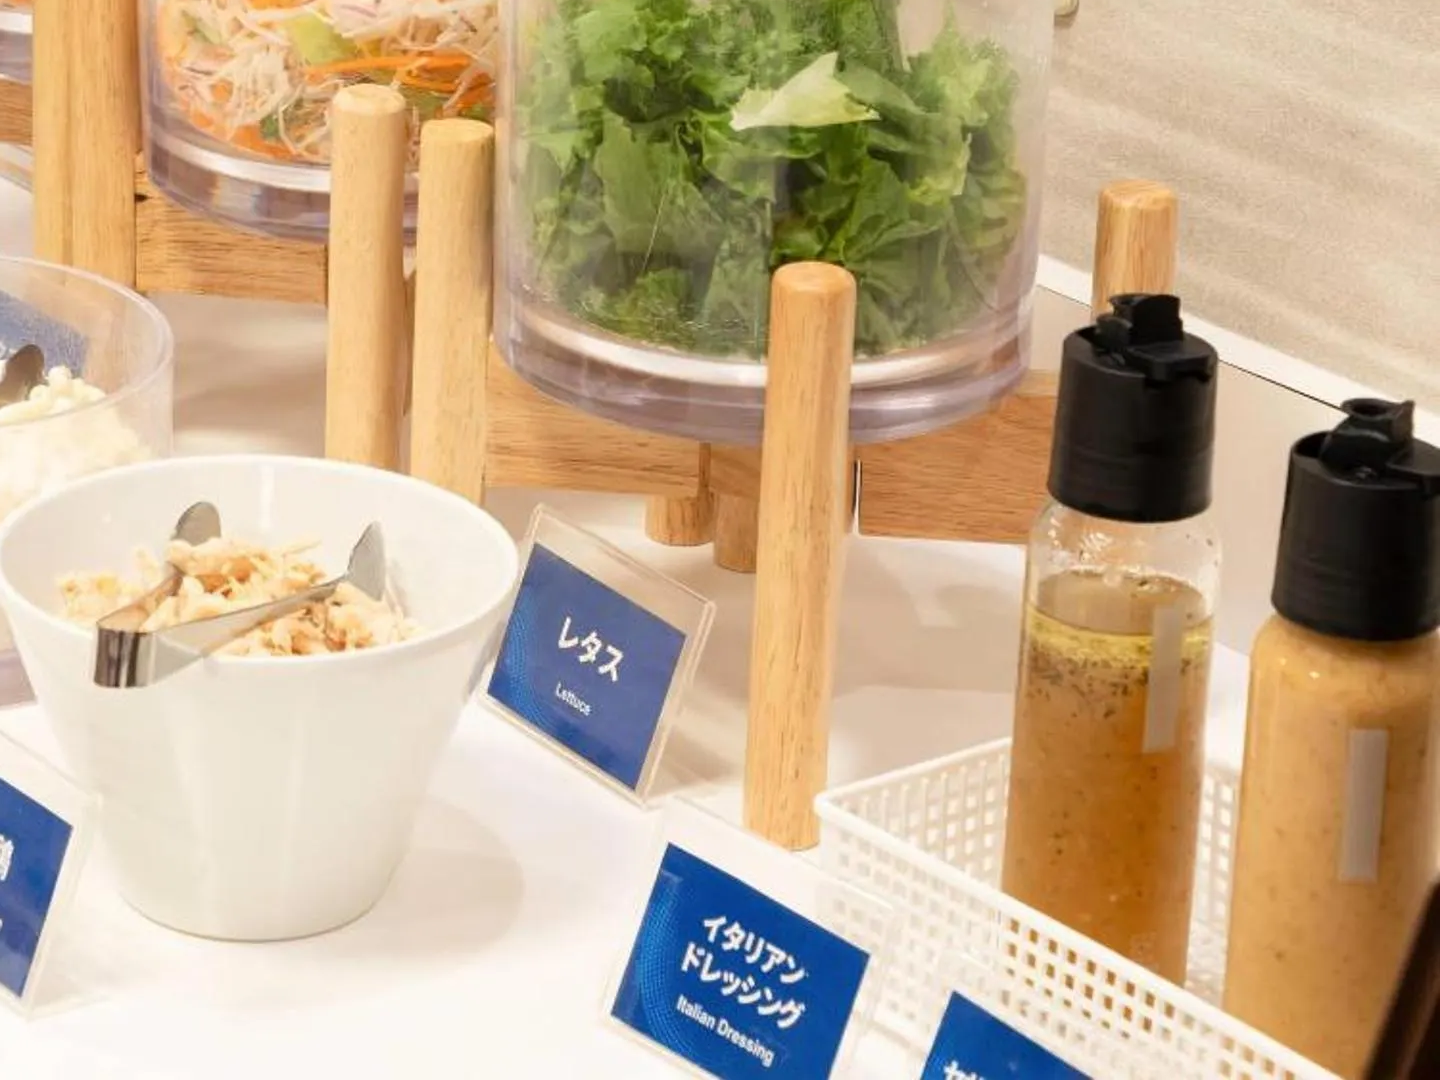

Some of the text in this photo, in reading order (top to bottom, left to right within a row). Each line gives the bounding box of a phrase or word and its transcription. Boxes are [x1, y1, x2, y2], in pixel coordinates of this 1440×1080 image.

[557, 616, 624, 682] レタス
[555, 680, 592, 717] Lettuce
[680, 940, 807, 1030] ドレッシング
[702, 915, 806, 985] イタリアン
[675, 993, 775, 1069] Italian Dressing
